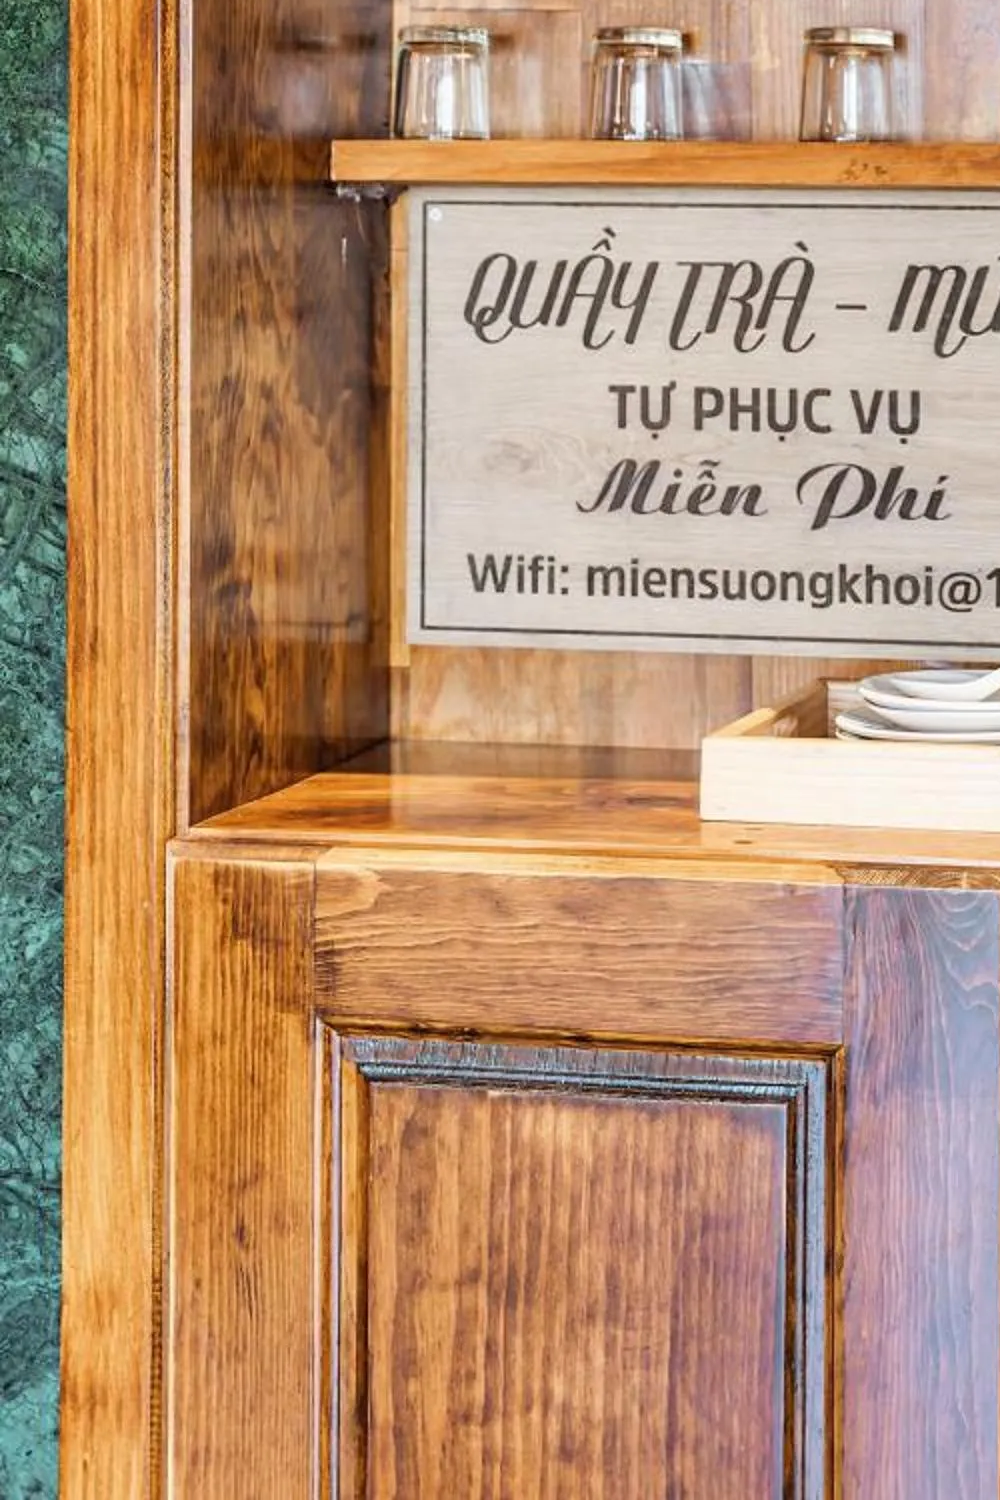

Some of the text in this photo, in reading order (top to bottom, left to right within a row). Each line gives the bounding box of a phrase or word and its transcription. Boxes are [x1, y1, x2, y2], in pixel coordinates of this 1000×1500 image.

[464, 228, 658, 350] QUẦY
[670, 242, 815, 353] TRÀ
[610, 382, 920, 445] TỰ PHỤC VỤ
[576, 460, 951, 530] Miễn Phí
[467, 554, 569, 596] Wifi:
